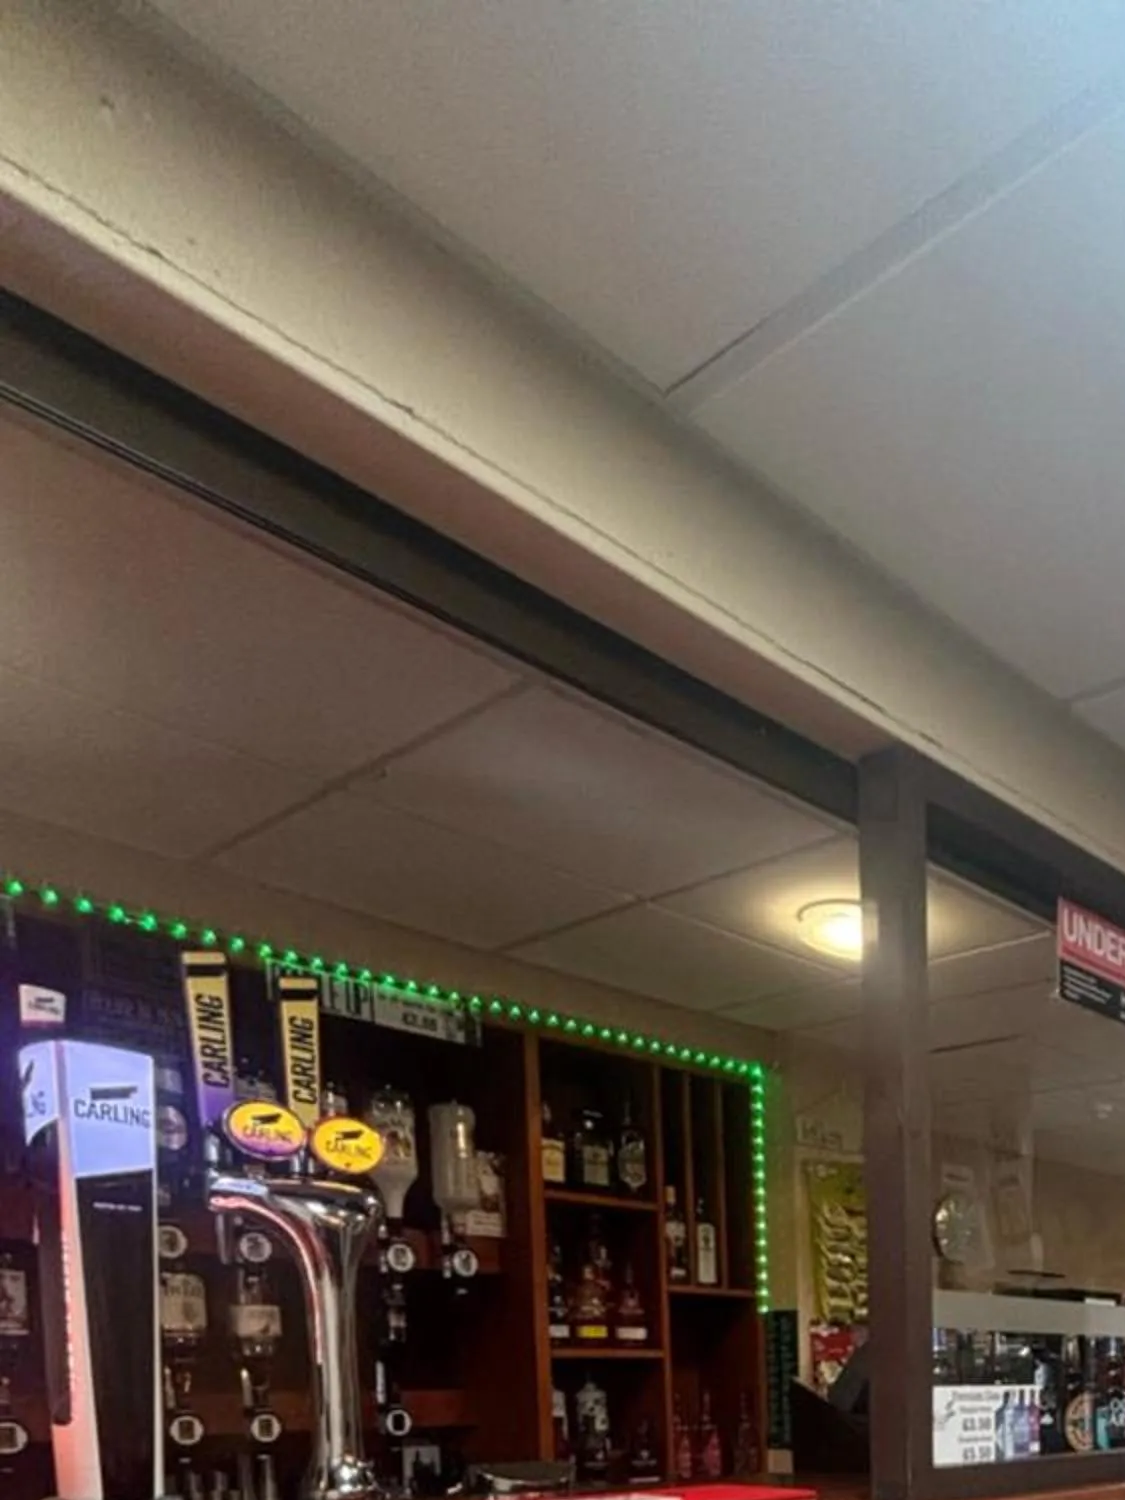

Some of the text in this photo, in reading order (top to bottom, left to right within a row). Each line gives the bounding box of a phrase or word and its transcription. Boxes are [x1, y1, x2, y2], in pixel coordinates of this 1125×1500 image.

[194, 993, 230, 1089] CARLING
[287, 1015, 318, 1105] CARLING
[73, 1099, 152, 1129] CARLING
